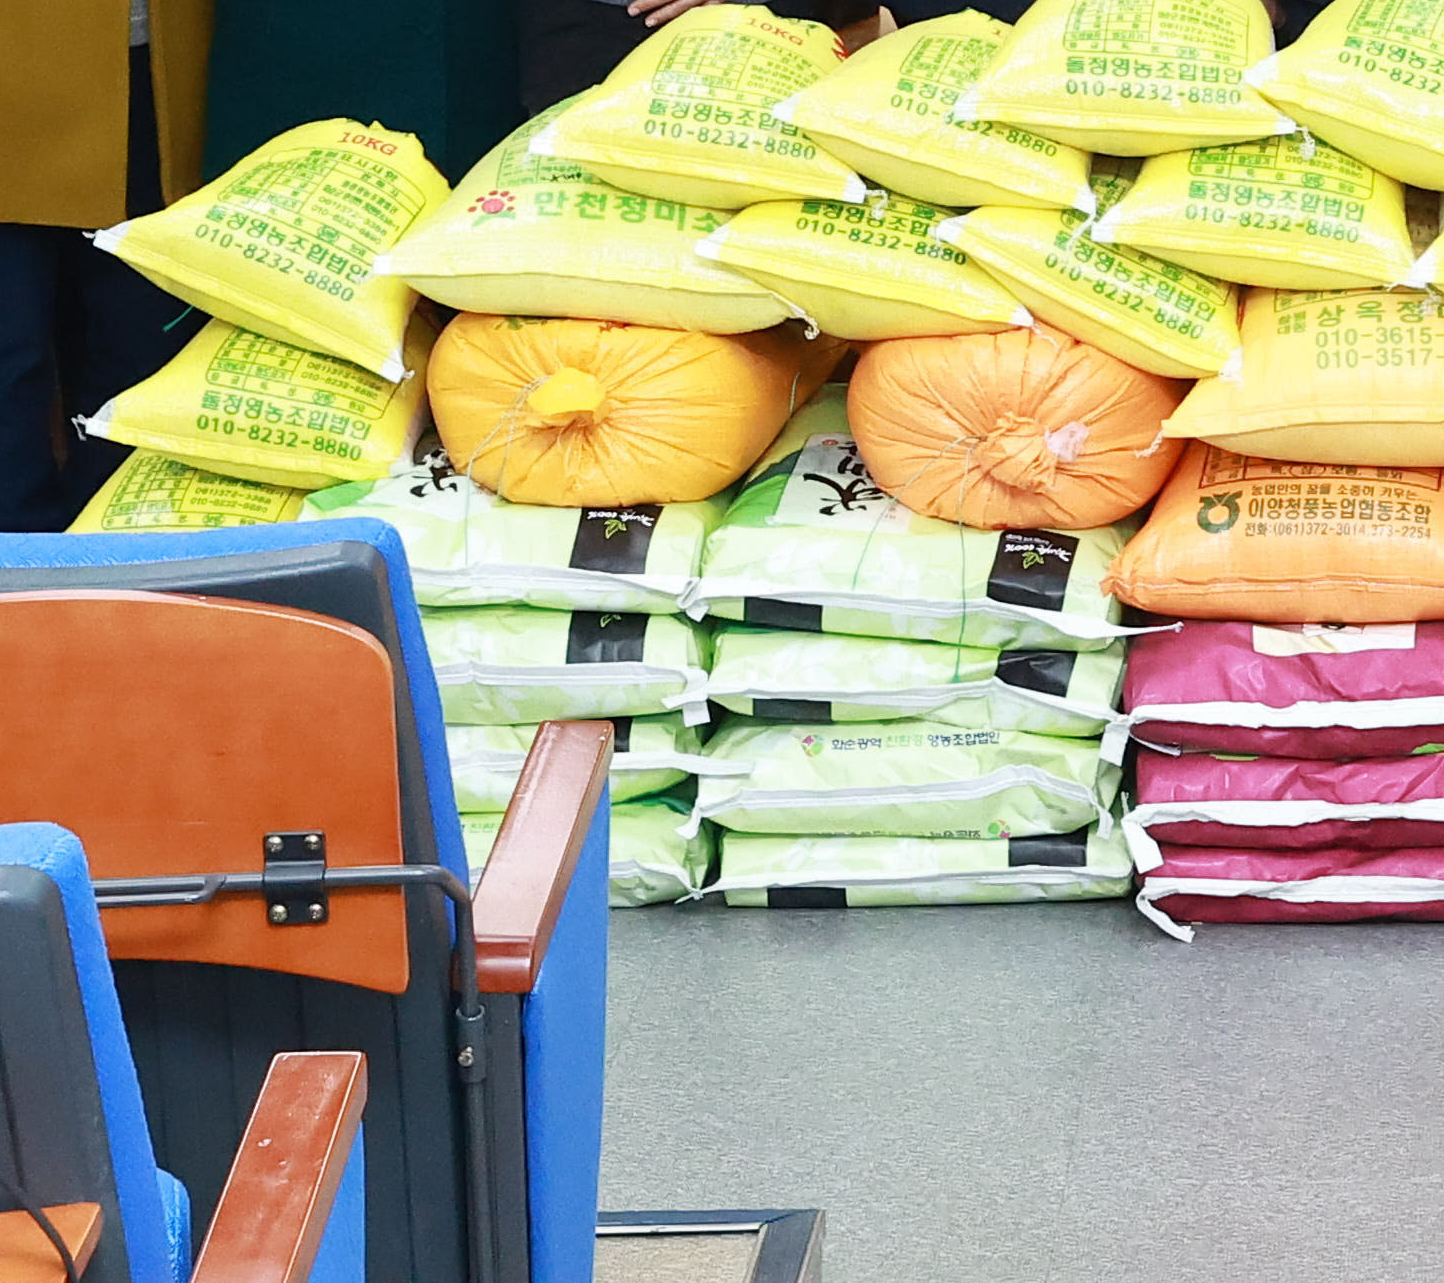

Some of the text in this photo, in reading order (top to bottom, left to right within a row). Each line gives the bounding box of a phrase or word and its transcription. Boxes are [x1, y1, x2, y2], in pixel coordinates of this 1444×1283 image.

[1066, 79, 1242, 104] 010-8232-8880
[339, 131, 398, 157] 10KG
[643, 118, 817, 160] 010-8232-8880
[533, 190, 725, 234] 만천정미소
[1185, 204, 1361, 244] 010-8232-8880
[194, 223, 356, 303] 010-8232-8880
[795, 216, 967, 267] 010-8232-8880
[1045, 252, 1203, 341] 010-8232-8880
[196, 414, 363, 463] 010-8232-8880
